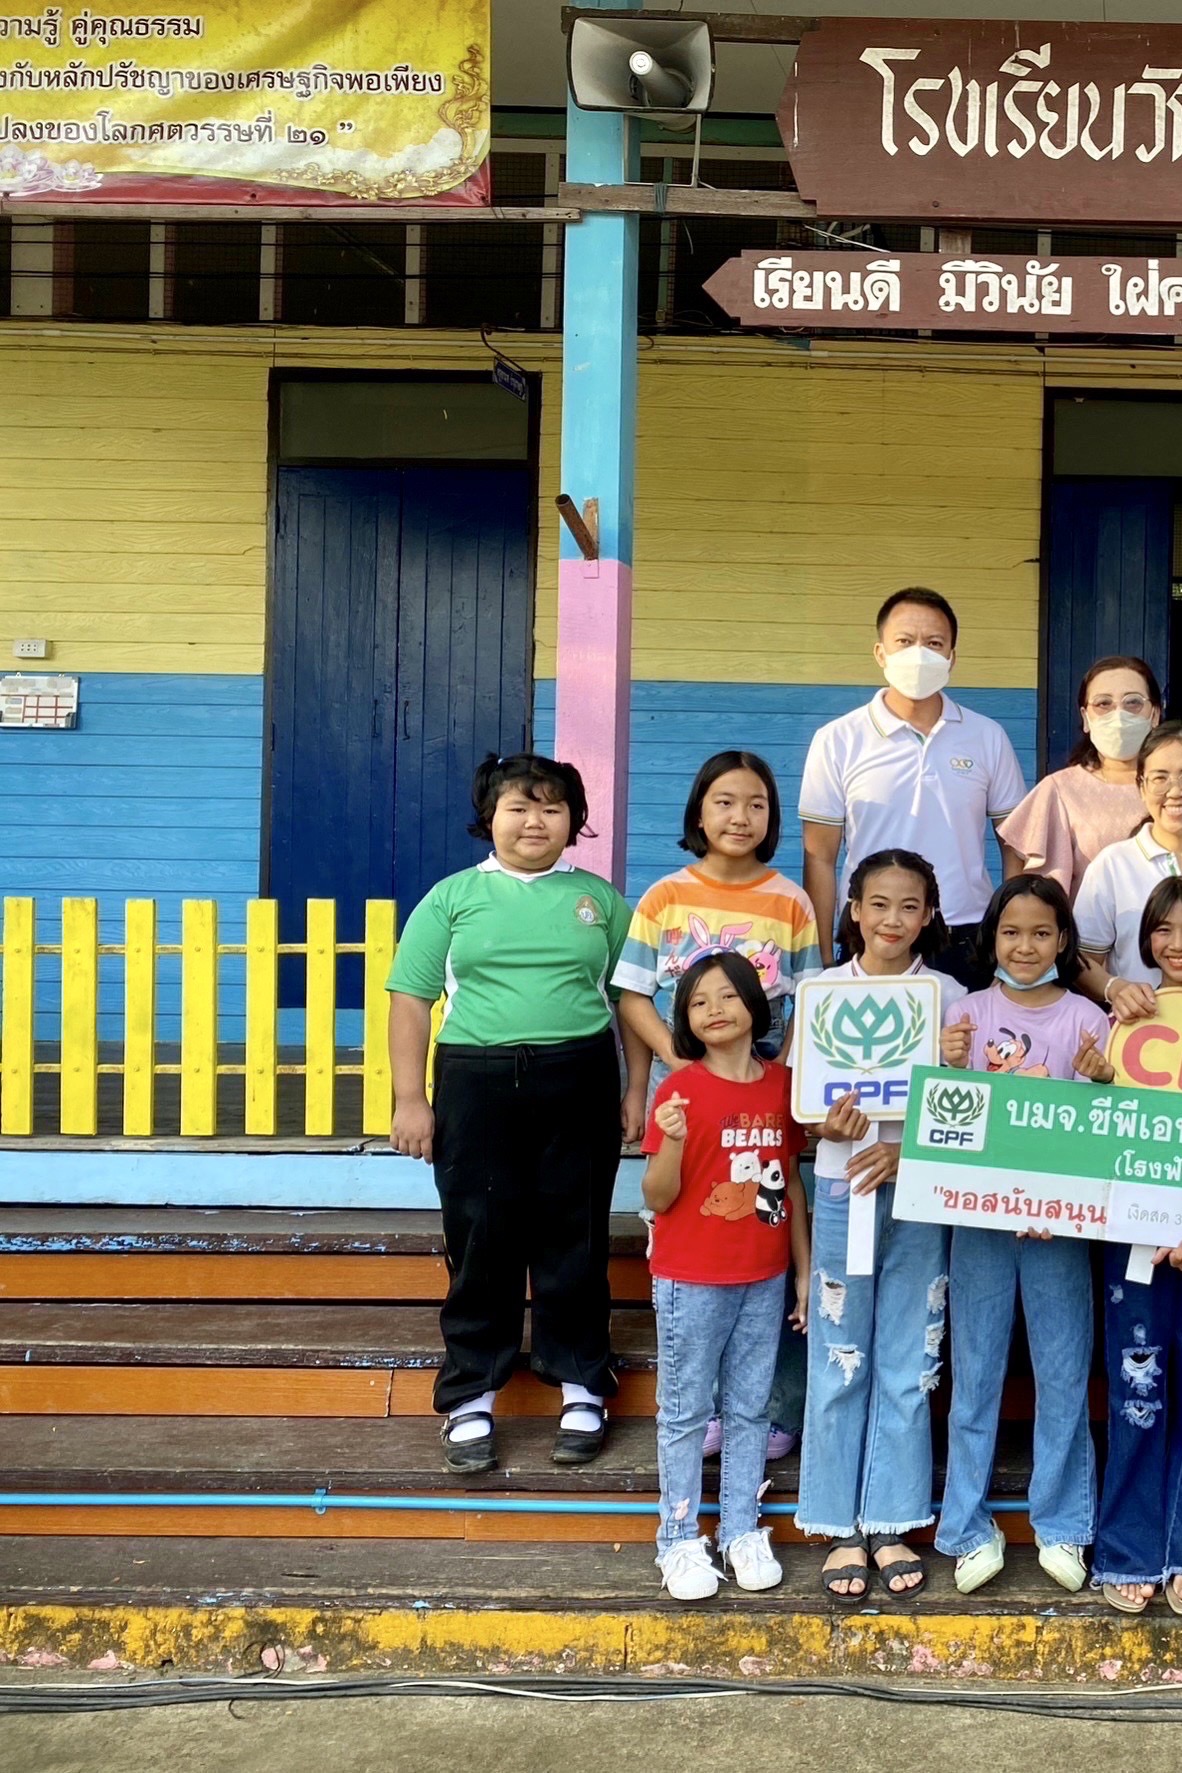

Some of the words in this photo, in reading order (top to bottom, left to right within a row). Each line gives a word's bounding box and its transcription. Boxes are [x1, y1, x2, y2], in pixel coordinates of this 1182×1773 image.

[71, 10, 203, 46] คู่คุณธรรม
[753, 257, 901, 312] เรียนดี
[938, 259, 1073, 316] มีวินัย
[823, 1080, 908, 1106] CPF
[740, 1112, 784, 1128] BARE
[721, 1128, 783, 1148] BEARS
[929, 1128, 974, 1147] CPF
